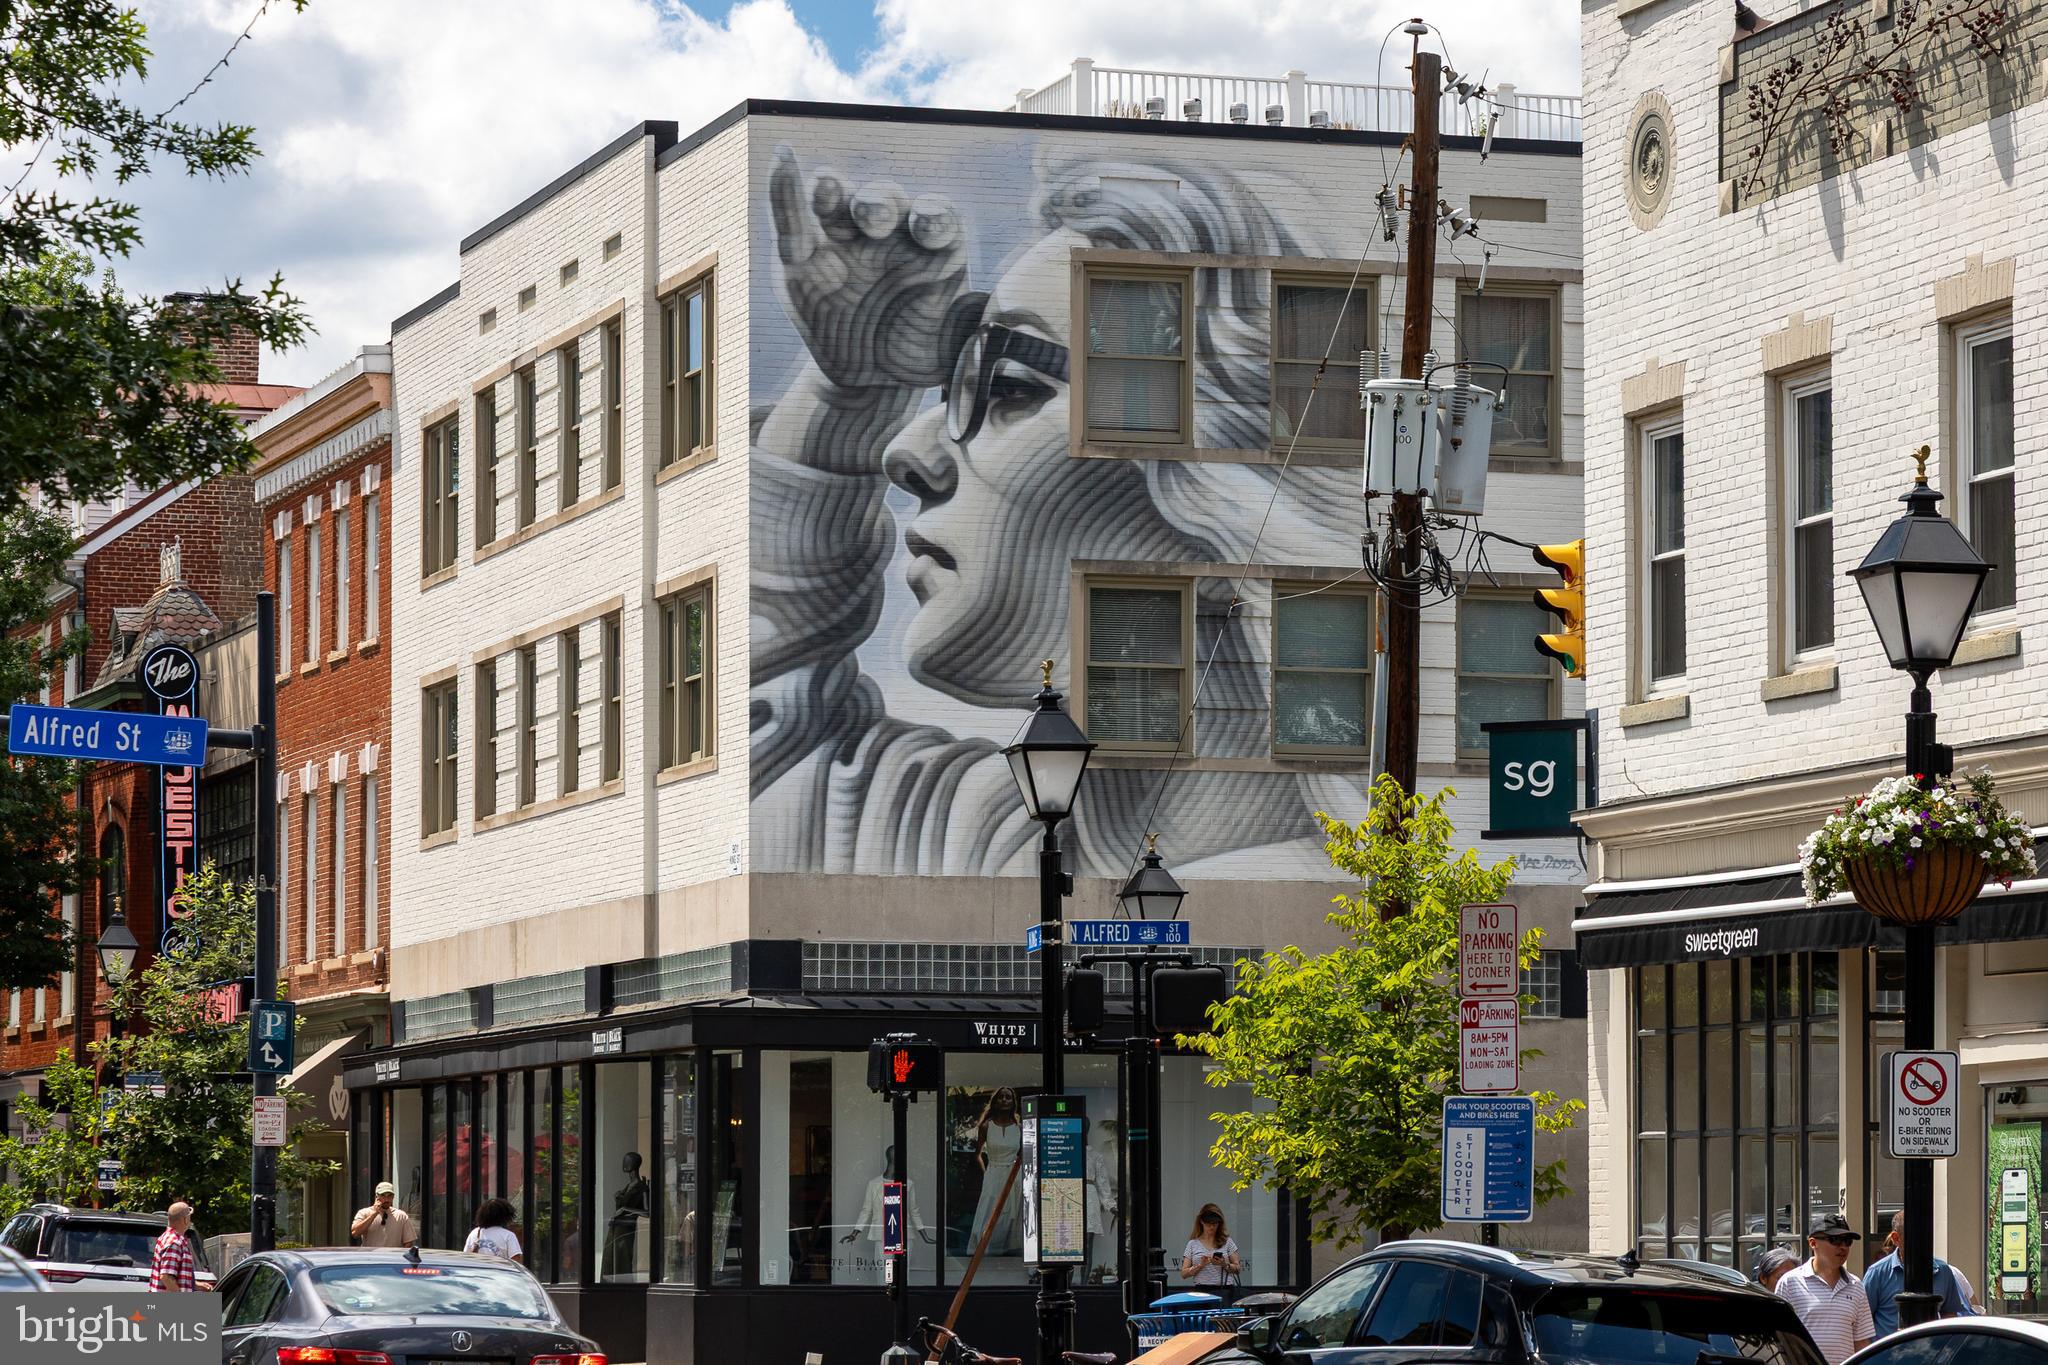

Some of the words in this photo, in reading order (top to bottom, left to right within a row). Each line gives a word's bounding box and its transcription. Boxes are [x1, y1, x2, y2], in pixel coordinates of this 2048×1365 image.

[1395, 435, 1412, 444] 00
[148, 654, 191, 686] The
[24, 715, 100, 749] Alfred
[116, 722, 141, 752] St
[1504, 760, 1556, 797] sg
[165, 704, 193, 919] MJESTIC
[1544, 855, 1581, 881] 2023
[1478, 912, 1499, 929] NO
[1070, 924, 1078, 942] N
[1084, 924, 1130, 942] ALFRED
[1169, 924, 1179, 932] ST
[1166, 933, 1180, 943] 100
[1465, 933, 1513, 950] PARKING
[1685, 928, 1758, 955] sweetgreen
[1467, 952, 1493, 964] HERE
[1499, 952, 1511, 964] TO
[1468, 966, 1510, 978] CORNER
[1462, 1006, 1478, 1023] NO
[1480, 1008, 1515, 1020] PARKING
[264, 1012, 282, 1037] P
[974, 1022, 1026, 1036] WHITE
[1471, 1032, 1508, 1043] 8AM-5PM
[1470, 1047, 1509, 1057] MON-SAT
[1465, 1061, 1494, 1070] LOADING
[1497, 1060, 1514, 1068] ZONE
[255, 1100, 264, 1110] NO
[1898, 1107, 1910, 1116] NO
[1912, 1107, 1951, 1116] SCOOTER
[1918, 1118, 1931, 1126] OR
[1898, 1127, 1924, 1135] E-BIKE
[1925, 1127, 1952, 1135] RIDING
[1900, 1137, 1911, 1145] ON
[1912, 1137, 1949, 1145] SIDEWALK
[856, 1257, 886, 1266] BLAC
